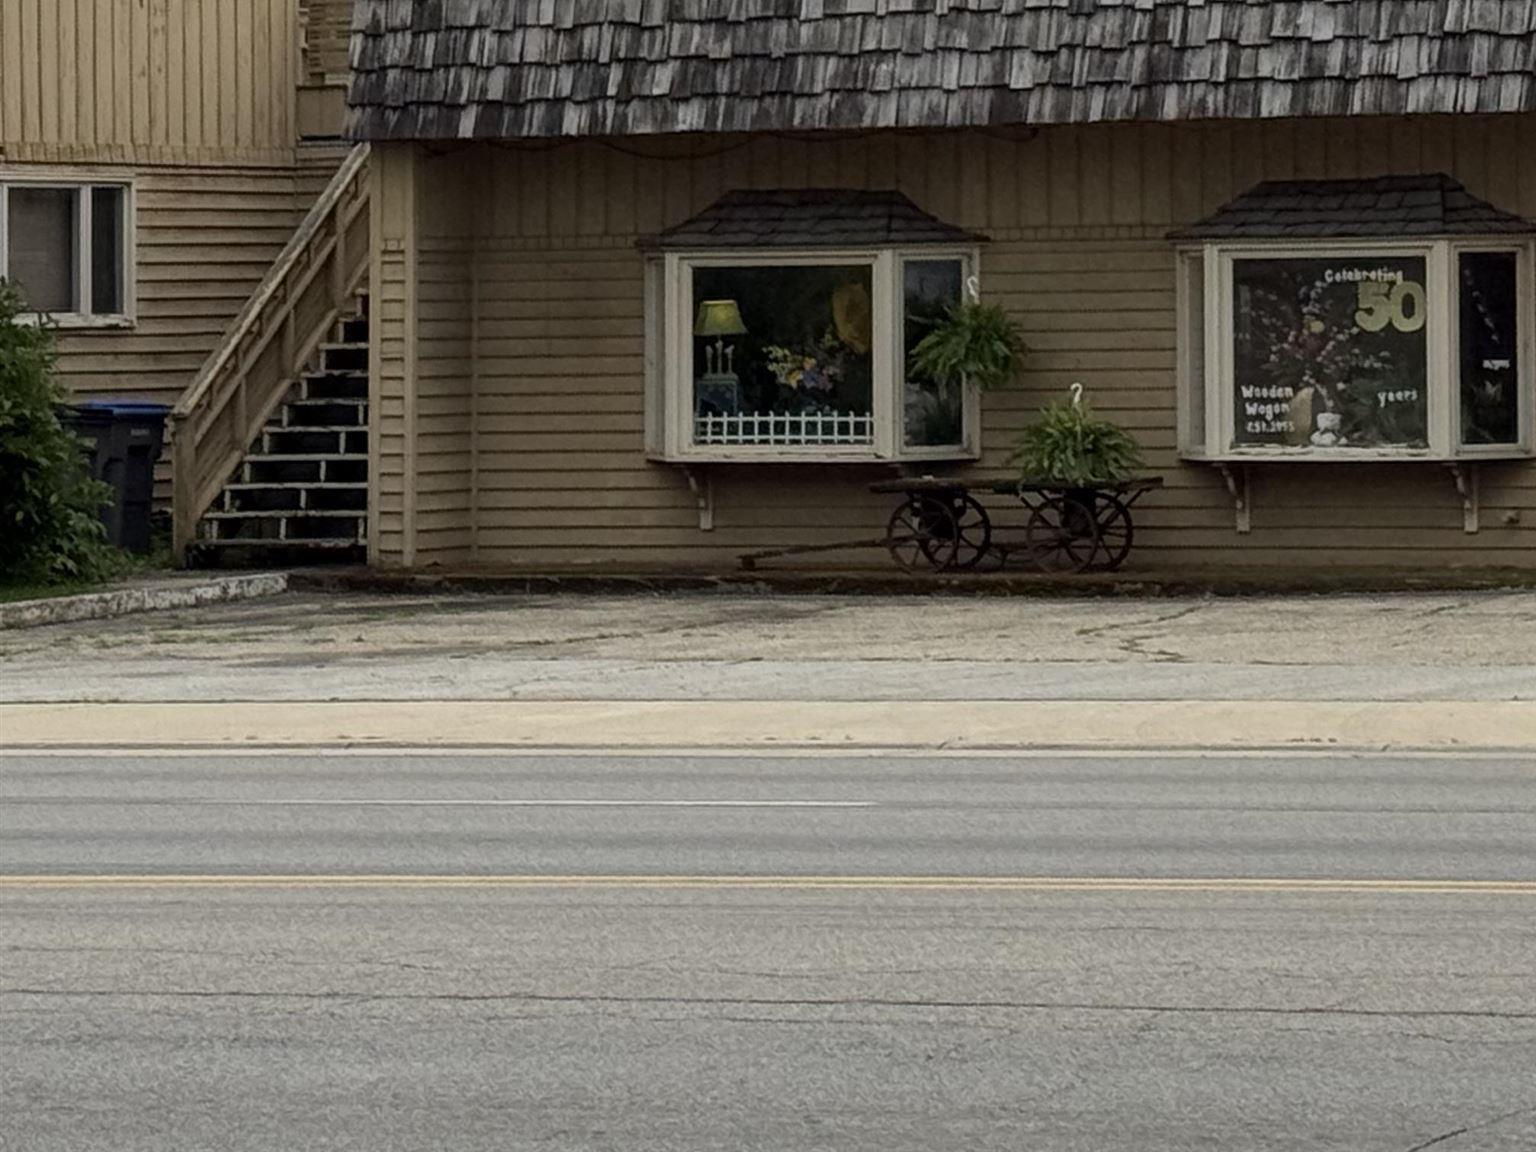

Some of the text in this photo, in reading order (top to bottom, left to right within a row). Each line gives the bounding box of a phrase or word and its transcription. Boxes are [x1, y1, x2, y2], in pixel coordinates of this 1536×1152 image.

[1324, 267, 1404, 284] Celebrating
[1354, 280, 1426, 333] 50
[1240, 384, 1294, 398] Wooden
[1377, 388, 1418, 408] years
[1244, 401, 1291, 421] Wagon
